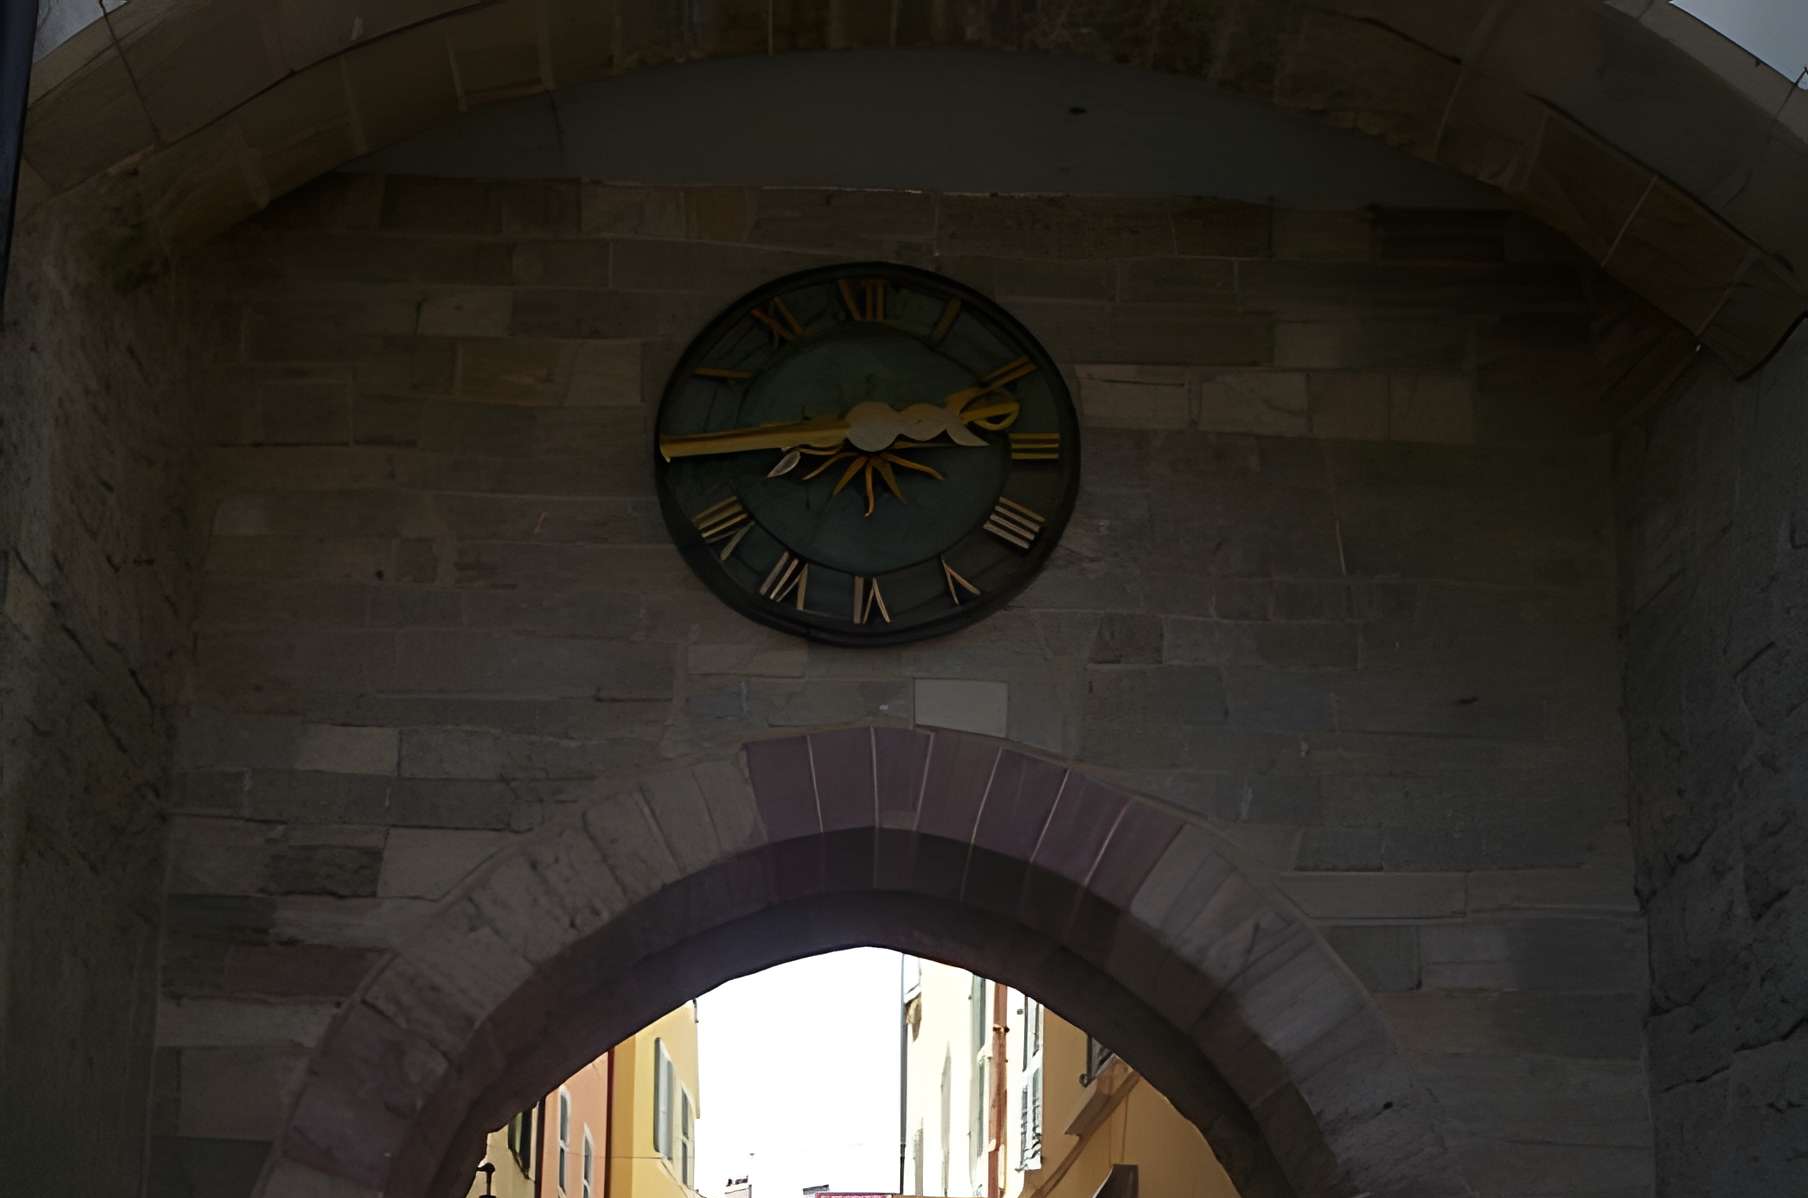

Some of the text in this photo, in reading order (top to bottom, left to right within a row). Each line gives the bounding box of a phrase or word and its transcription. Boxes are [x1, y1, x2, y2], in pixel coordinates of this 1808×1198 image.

[1008, 432, 1061, 461] III
[693, 495, 755, 561] VIII
[984, 495, 1047, 550] IIII
[759, 550, 809, 610] VII
[853, 575, 892, 625] VI
[941, 553, 981, 606] V
